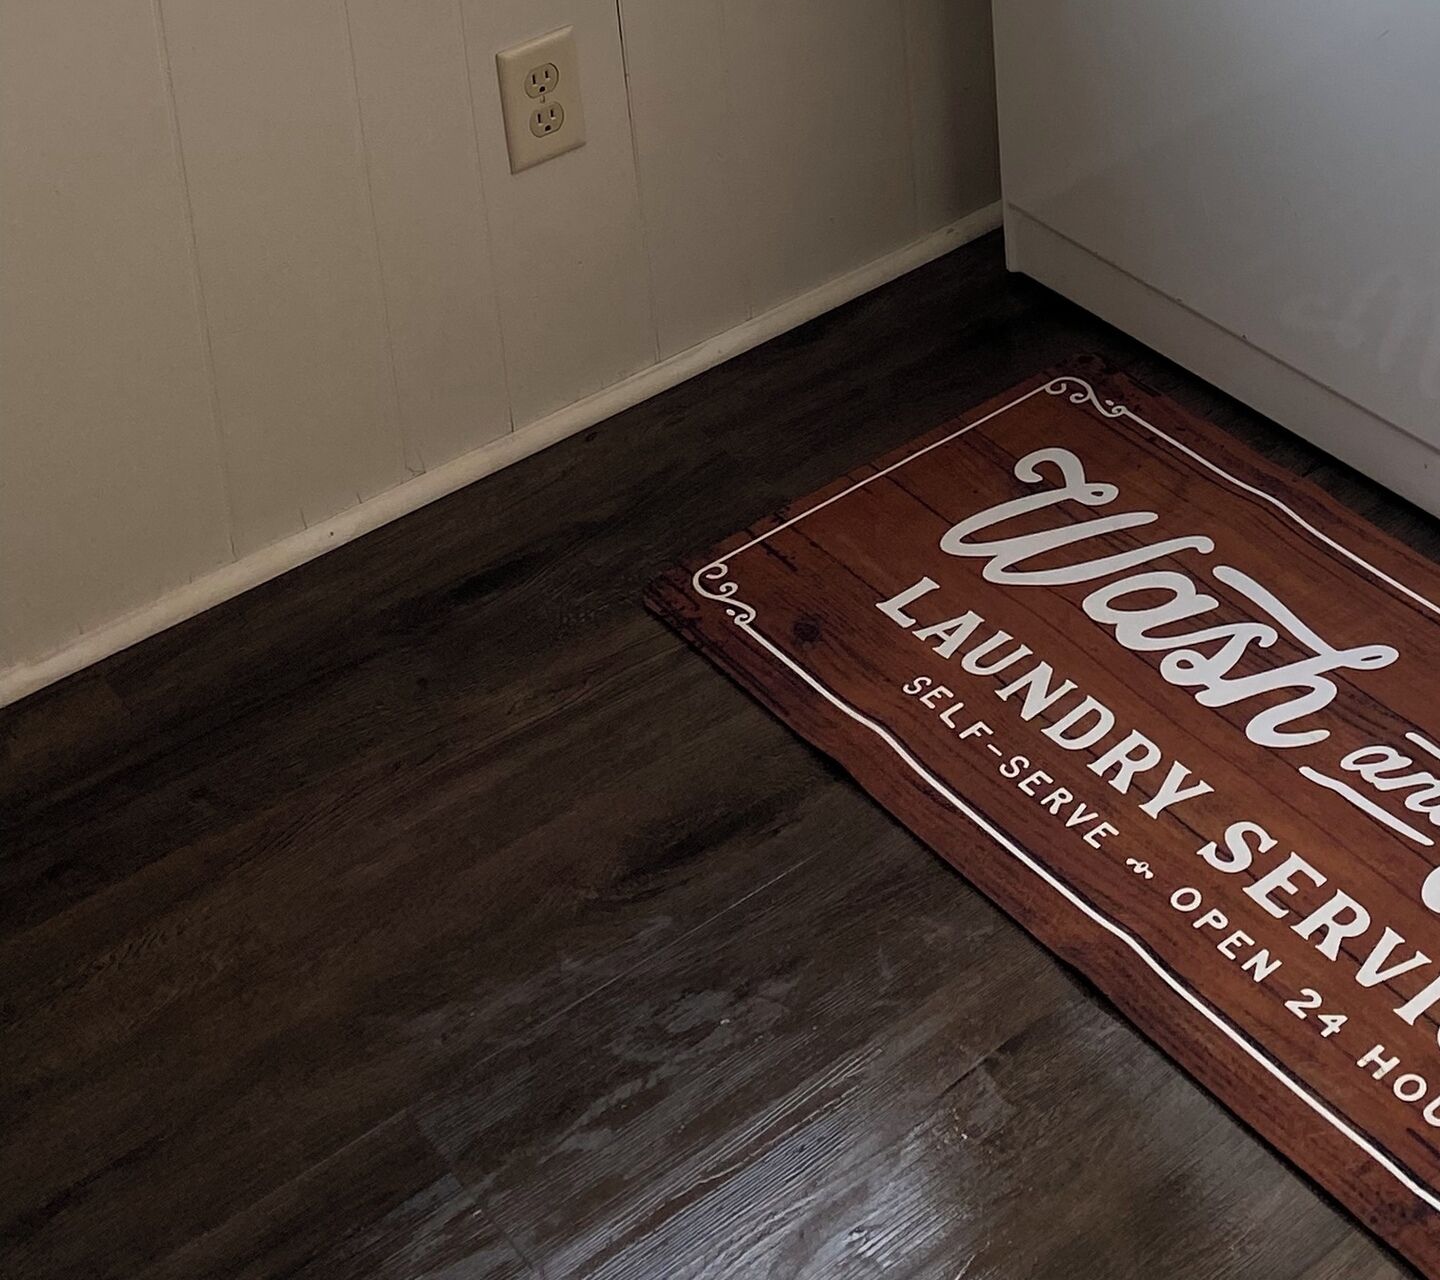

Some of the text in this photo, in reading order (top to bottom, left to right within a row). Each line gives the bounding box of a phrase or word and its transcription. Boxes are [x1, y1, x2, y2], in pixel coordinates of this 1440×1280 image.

[875, 576, 1215, 820] LAUNDRY
[939, 446, 1400, 748] Wash
[902, 675, 1120, 850] SELF-SERVE
[1170, 886, 1283, 983] OPEN
[1284, 988, 1349, 1038] 24
